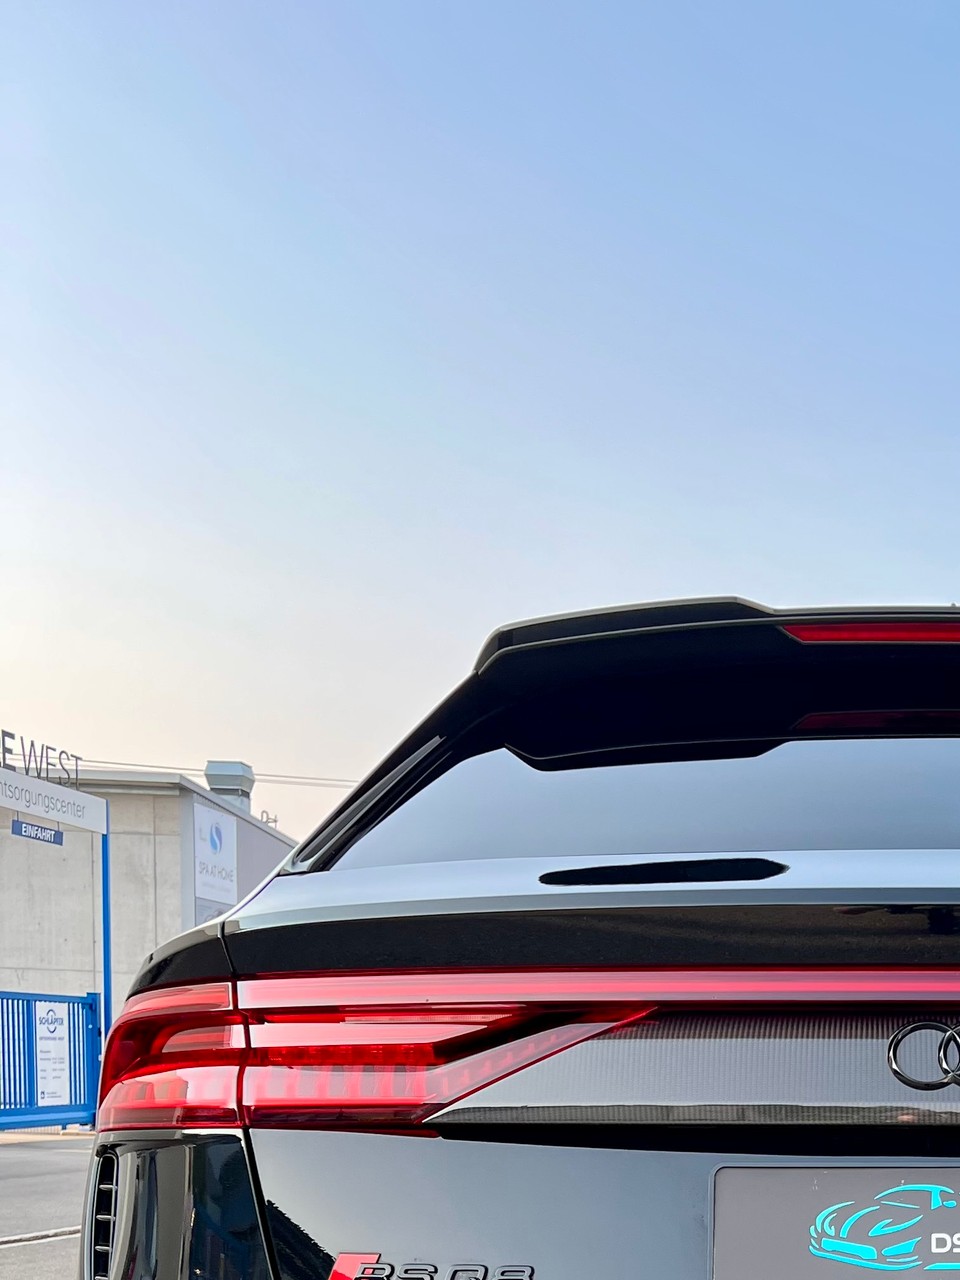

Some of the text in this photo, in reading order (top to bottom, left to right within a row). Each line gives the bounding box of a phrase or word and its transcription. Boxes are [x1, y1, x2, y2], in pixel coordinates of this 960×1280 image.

[20, 735, 83, 791] WEST
[21, 823, 56, 843] EINFAHRT
[199, 861, 210, 876] SPA
[217, 865, 234, 883] HOME
